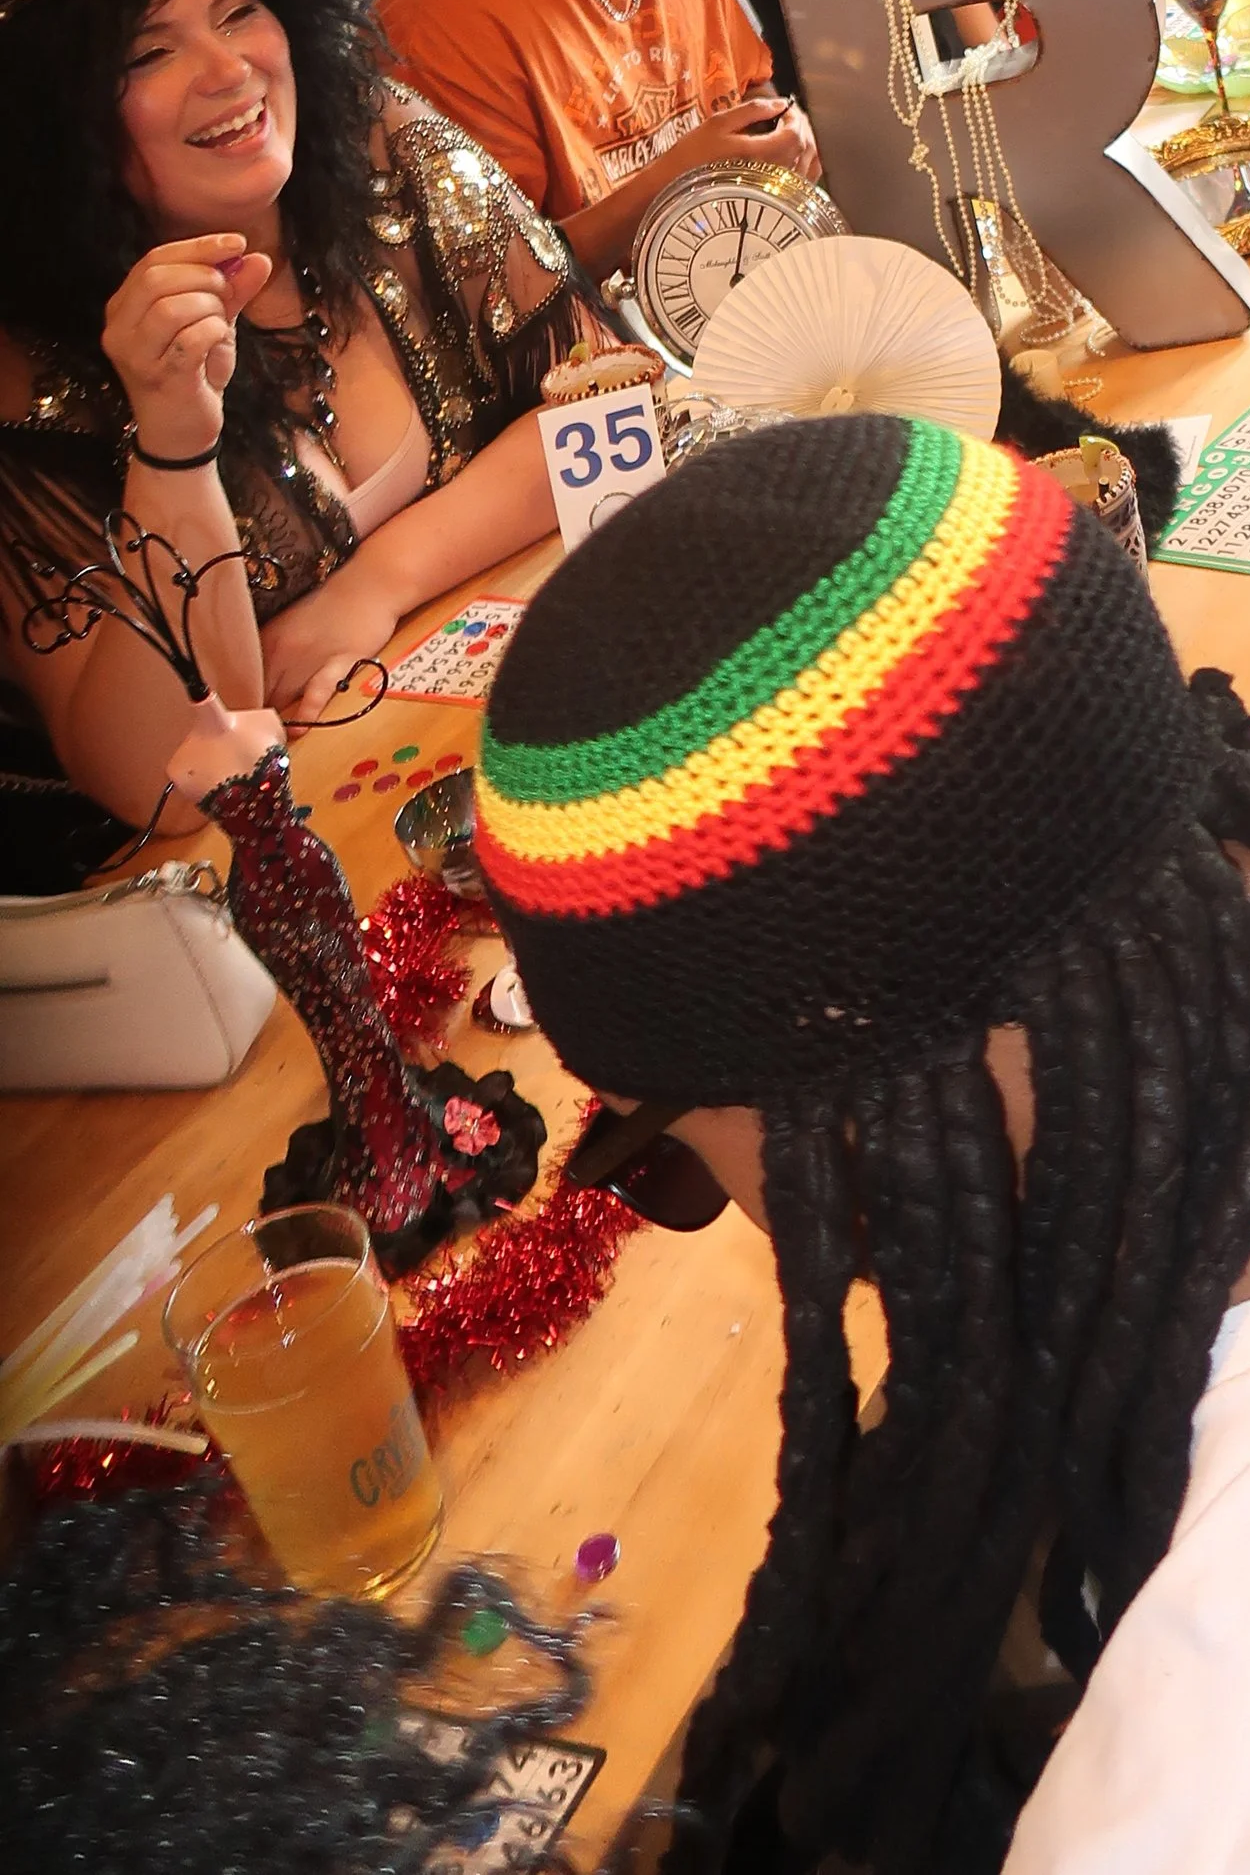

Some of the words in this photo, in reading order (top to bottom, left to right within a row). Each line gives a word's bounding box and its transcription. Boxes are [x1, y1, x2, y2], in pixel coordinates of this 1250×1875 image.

[622, 50, 642, 69] TO
[555, 404, 653, 489] 35
[1219, 437, 1247, 449] 67
[1168, 538, 1188, 547] 2
[1182, 517, 1208, 531] 18
[1199, 502, 1224, 517] 38
[1217, 485, 1240, 499] 60
[1191, 537, 1217, 551] 12
[1208, 520, 1231, 536] 27
[1227, 504, 1250, 520] 43
[1217, 541, 1243, 555] 11
